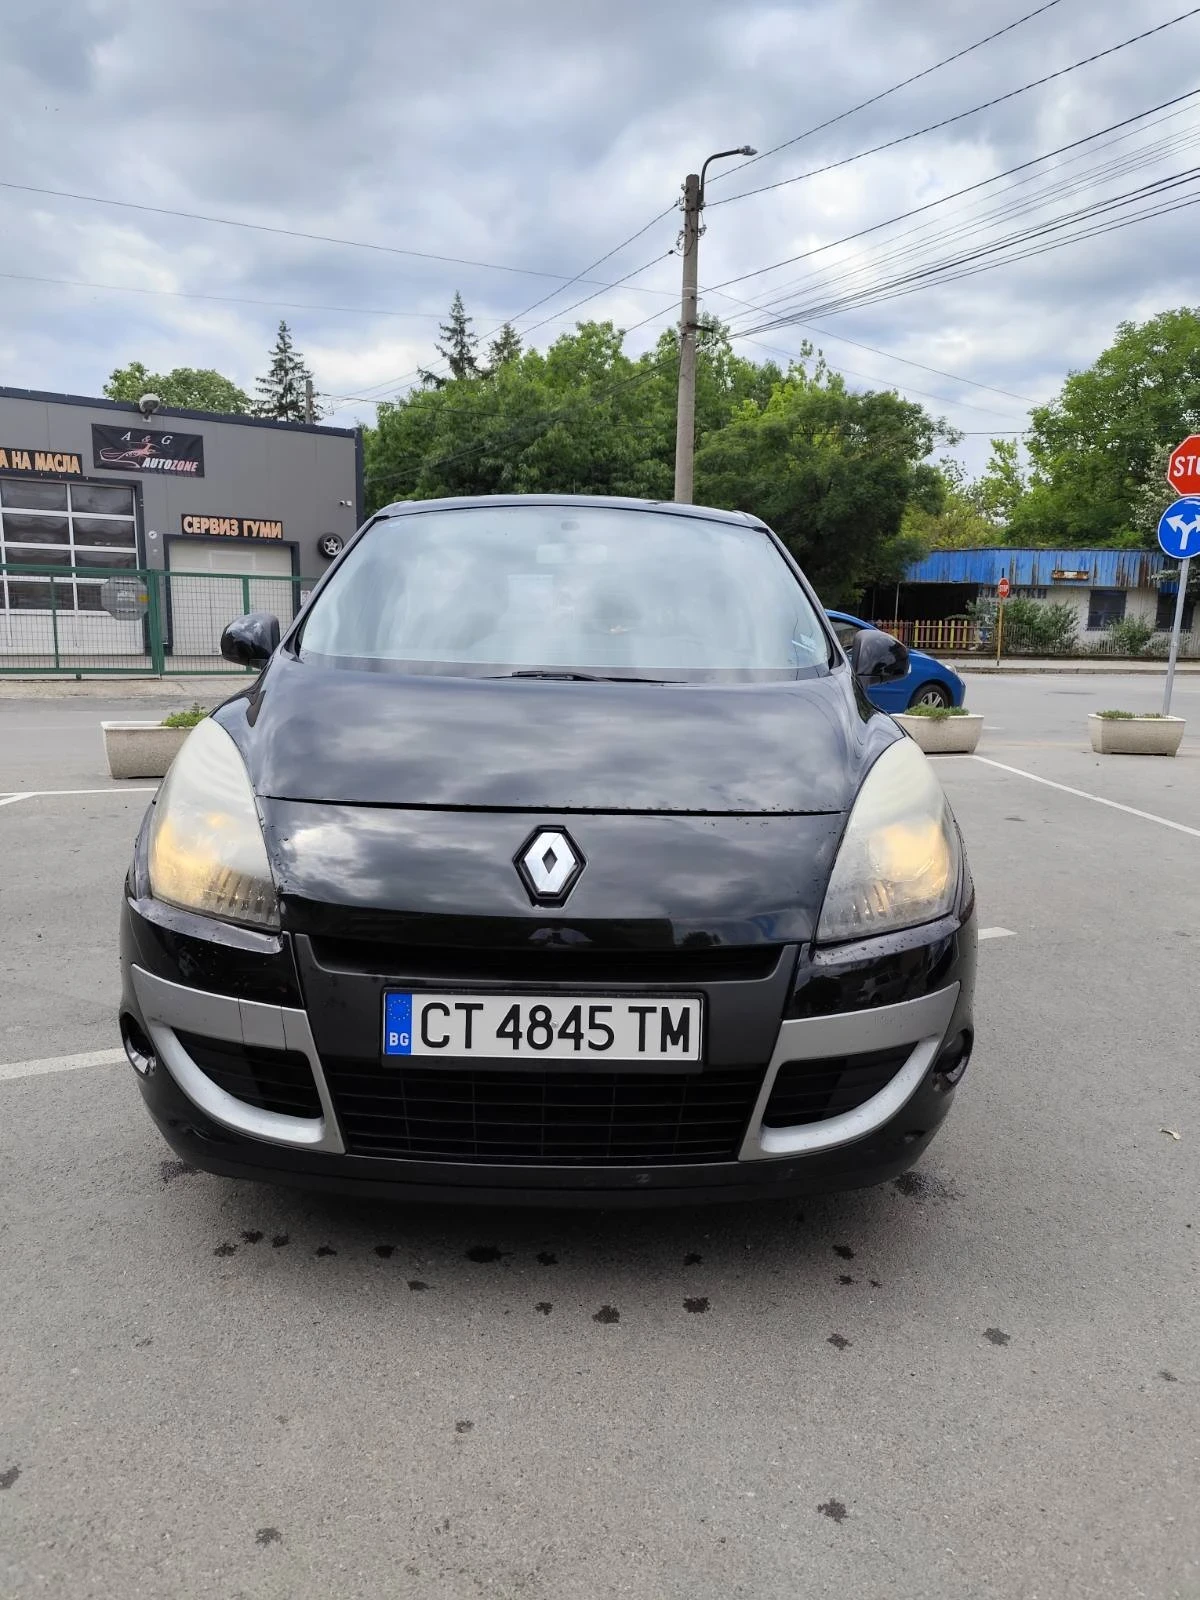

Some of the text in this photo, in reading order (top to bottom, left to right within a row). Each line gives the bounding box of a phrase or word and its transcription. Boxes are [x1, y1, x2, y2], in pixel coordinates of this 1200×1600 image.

[121, 431, 132, 441] A
[160, 435, 173, 445] G
[11, 450, 32, 470] НА
[34, 452, 81, 474] МАСЛА
[142, 457, 199, 472] AUTOZONE
[183, 515, 282, 539] СЕРВИЗ ГУМИ
[420, 1002, 691, 1053] CT 4845 TM
[389, 1031, 410, 1047] BG
